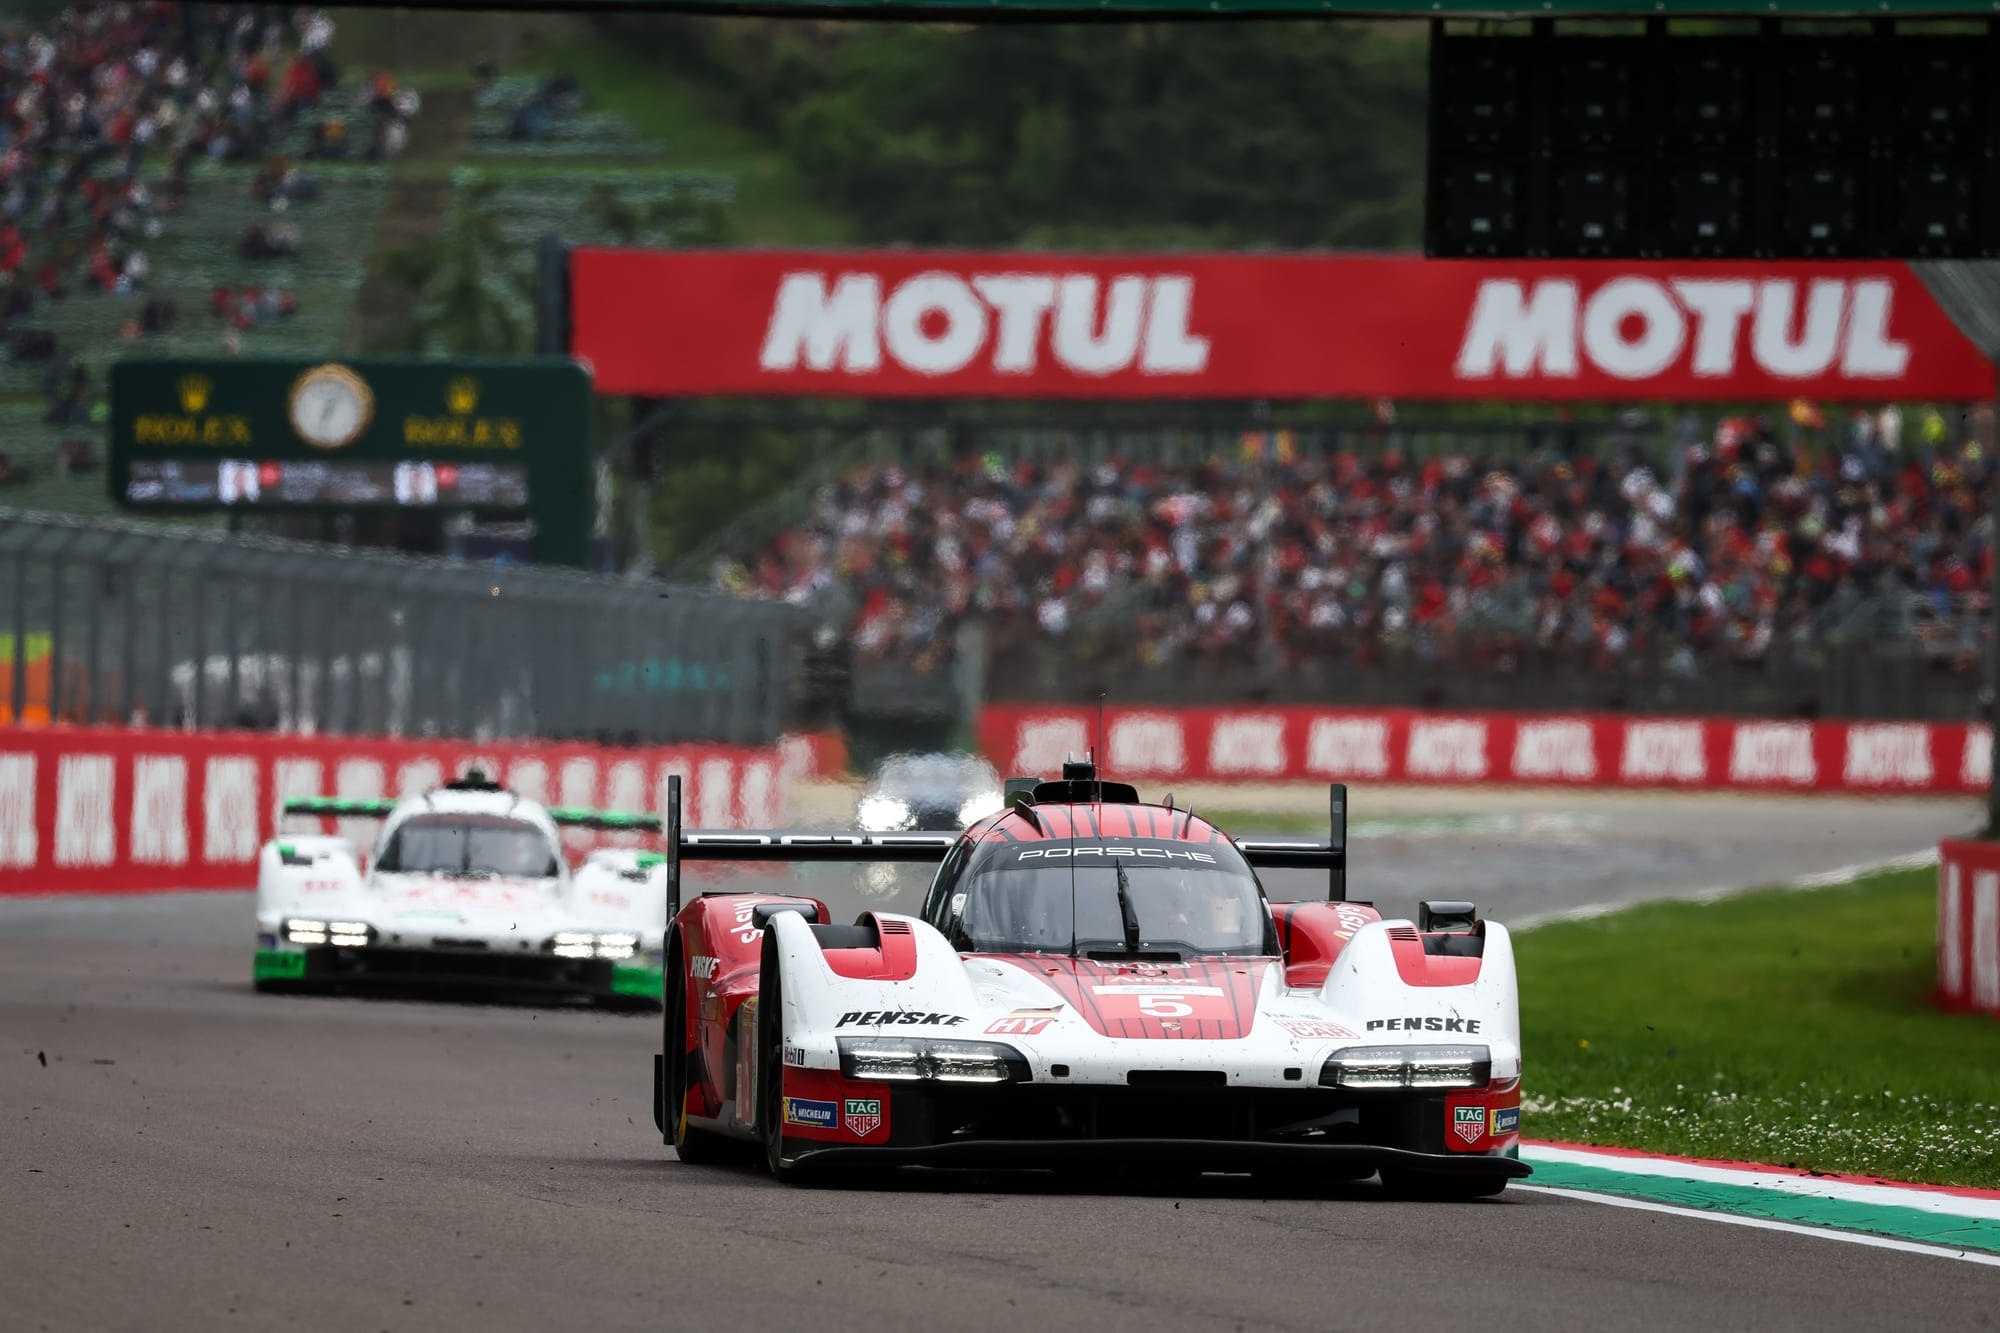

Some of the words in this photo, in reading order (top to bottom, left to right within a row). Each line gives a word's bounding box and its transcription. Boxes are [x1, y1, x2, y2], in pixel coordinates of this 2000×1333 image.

[759, 270, 1211, 375] MOTUL
[1456, 274, 1909, 379] MOTUL
[1018, 847, 1217, 864] PORSCHE
[690, 955, 720, 979] PENSKE
[1138, 994, 1193, 1017] 5
[835, 1011, 969, 1028] PENSKE
[1366, 1017, 1481, 1034] PENSKE
[1291, 1026, 1354, 1038] CAR
[798, 1107, 832, 1120] MICHELIN
[847, 1102, 877, 1114] TAG
[1457, 1109, 1483, 1121] TAG
[846, 1115, 878, 1134] HEUER
[1456, 1123, 1483, 1141] HEUER
